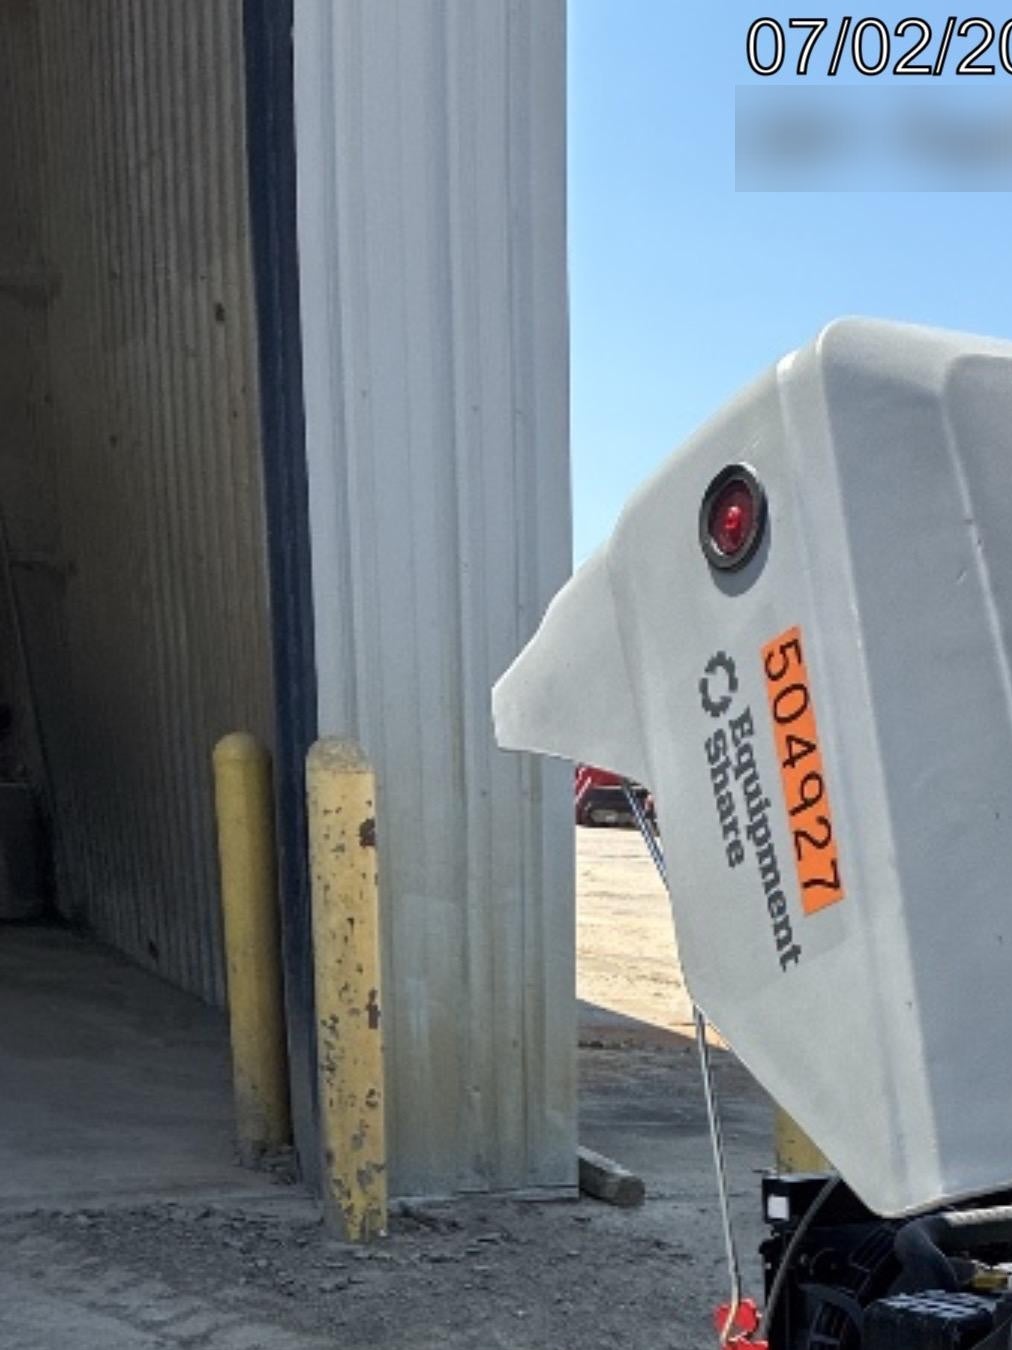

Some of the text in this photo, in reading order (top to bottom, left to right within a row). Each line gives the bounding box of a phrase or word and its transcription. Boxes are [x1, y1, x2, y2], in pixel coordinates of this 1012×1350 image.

[704, 727, 745, 868] Share
[729, 705, 801, 972] Equipment
[764, 638, 841, 890] 504927
